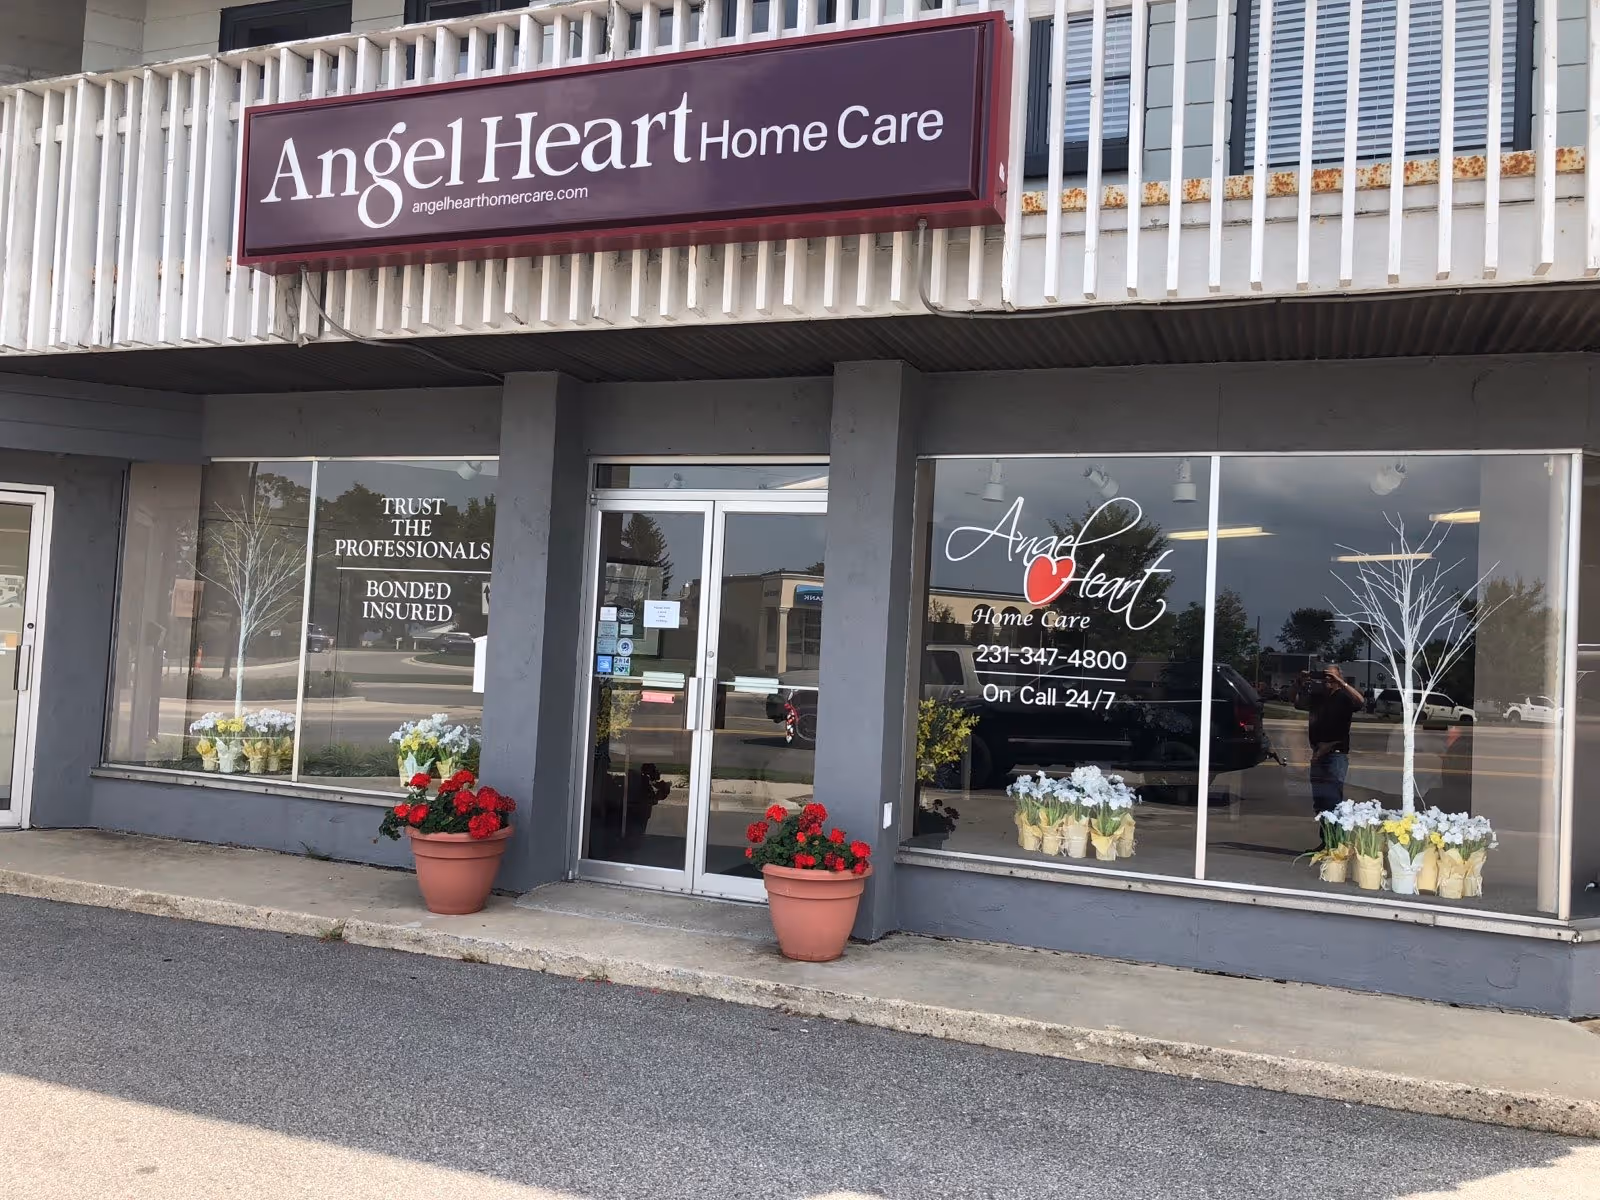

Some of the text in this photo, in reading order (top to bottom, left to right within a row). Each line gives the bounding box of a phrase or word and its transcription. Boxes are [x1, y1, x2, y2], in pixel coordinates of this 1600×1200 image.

[260, 91, 944, 229] Angel Heart Home Care
[411, 186, 588, 216] angelhearthomercare.com
[381, 497, 445, 516] TRUST
[391, 519, 432, 537] THE
[945, 496, 1142, 582] Angel
[334, 539, 491, 560] PROFESSIONALS
[366, 580, 451, 600] BONDED
[1061, 549, 1174, 631] Heart
[362, 601, 453, 622] INSURED
[971, 607, 1091, 629] Home Care
[975, 644, 1127, 671] 231-347-4800
[982, 683, 1116, 711] On Call 24/7
